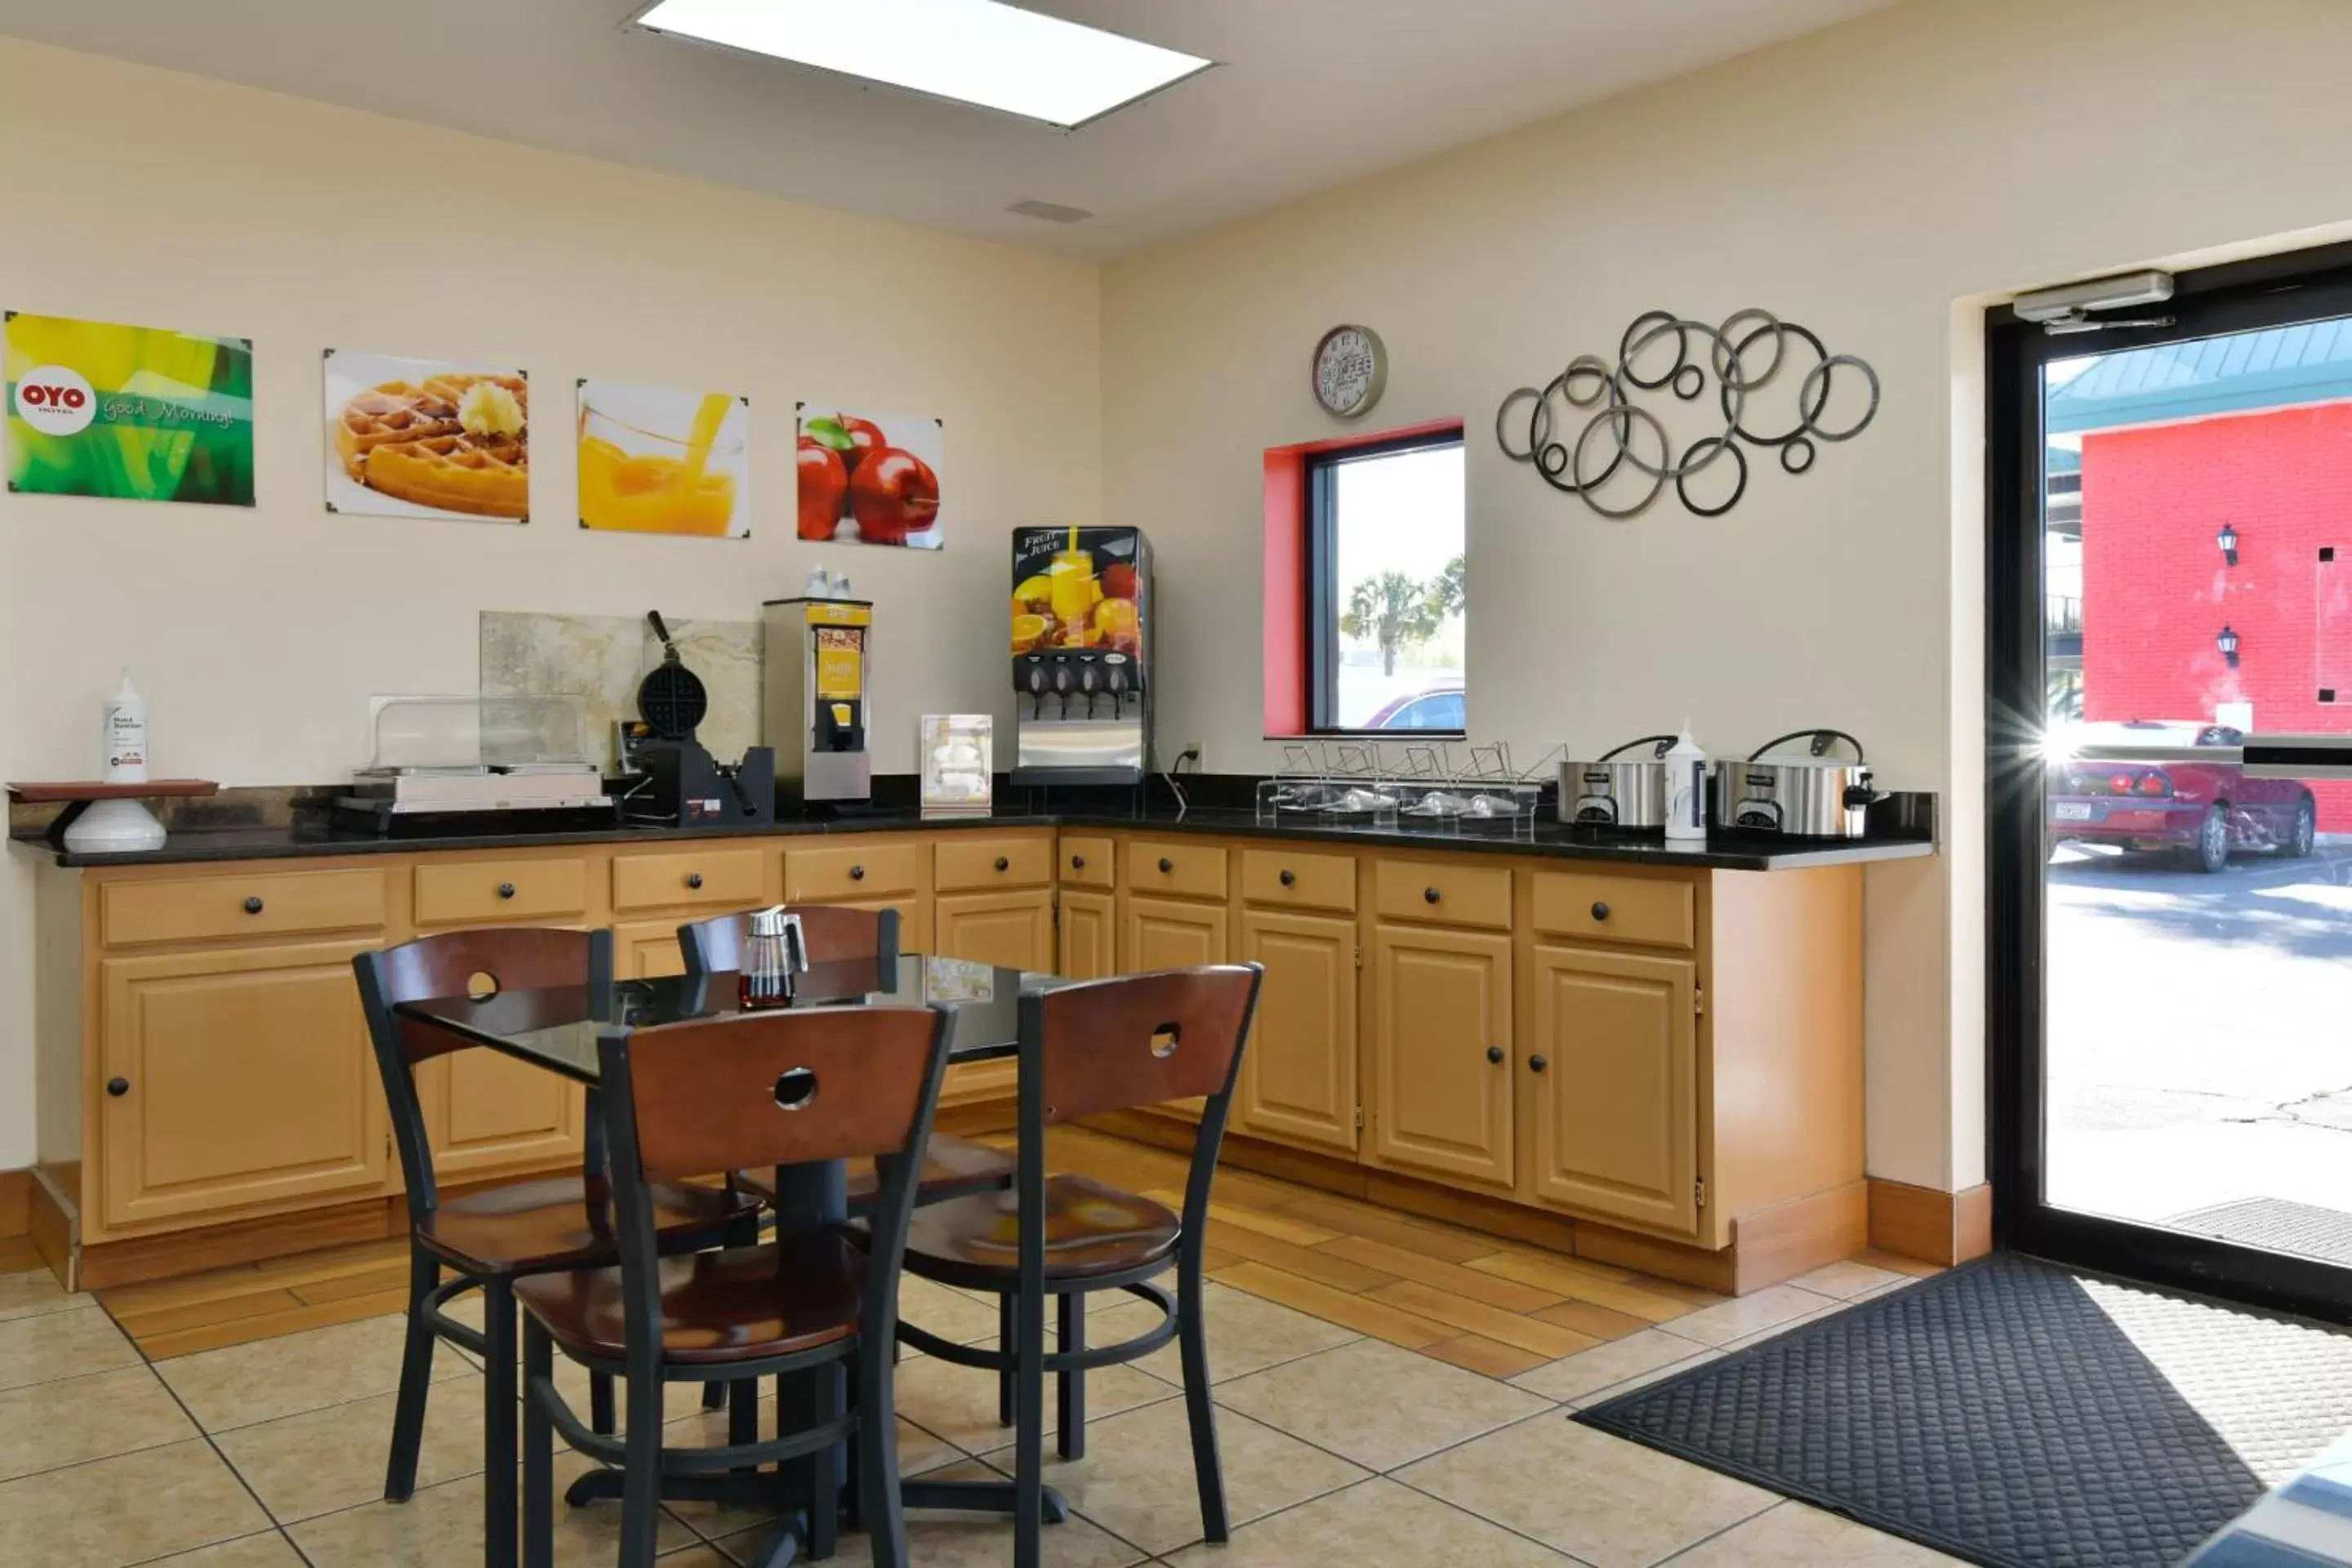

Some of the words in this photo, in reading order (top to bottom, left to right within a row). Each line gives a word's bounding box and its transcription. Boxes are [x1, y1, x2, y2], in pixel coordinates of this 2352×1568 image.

[23, 385, 85, 408] OYO
[103, 396, 146, 421] Good
[1024, 531, 1056, 549] FRUIT
[1030, 541, 1060, 557] JUICE
